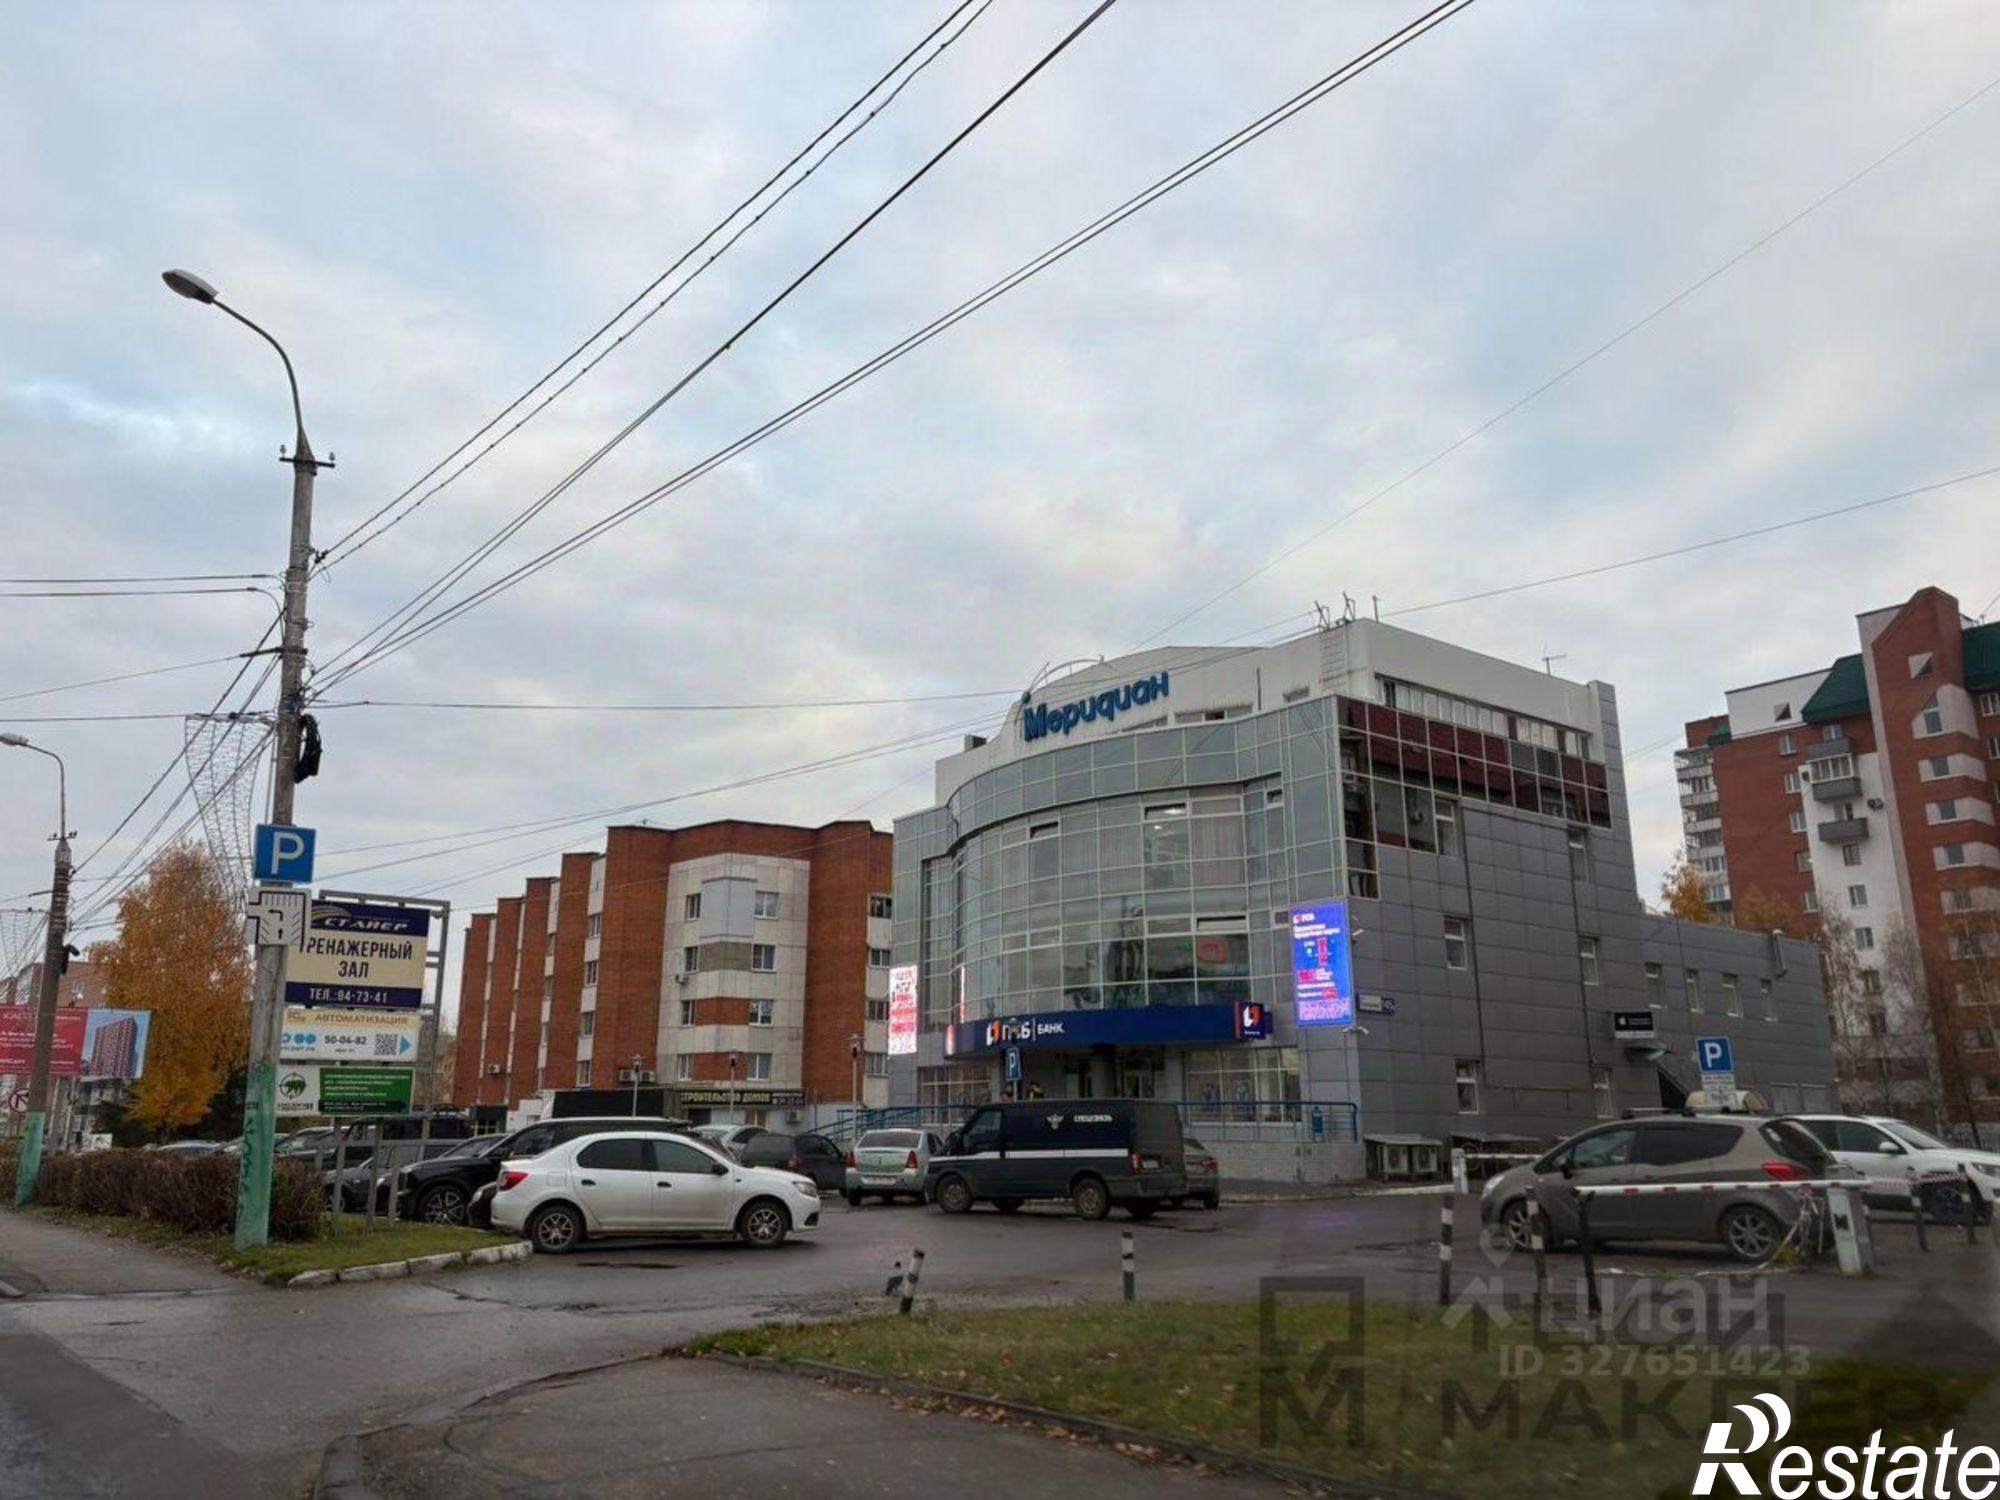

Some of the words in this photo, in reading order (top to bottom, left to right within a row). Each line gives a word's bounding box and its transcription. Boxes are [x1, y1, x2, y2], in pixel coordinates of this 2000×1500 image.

[338, 960, 370, 979] ЗАЛ
[314, 1014, 408, 1025] АВТОМАТИЗАЦИЯ
[1037, 1022, 1065, 1035] БАНК
